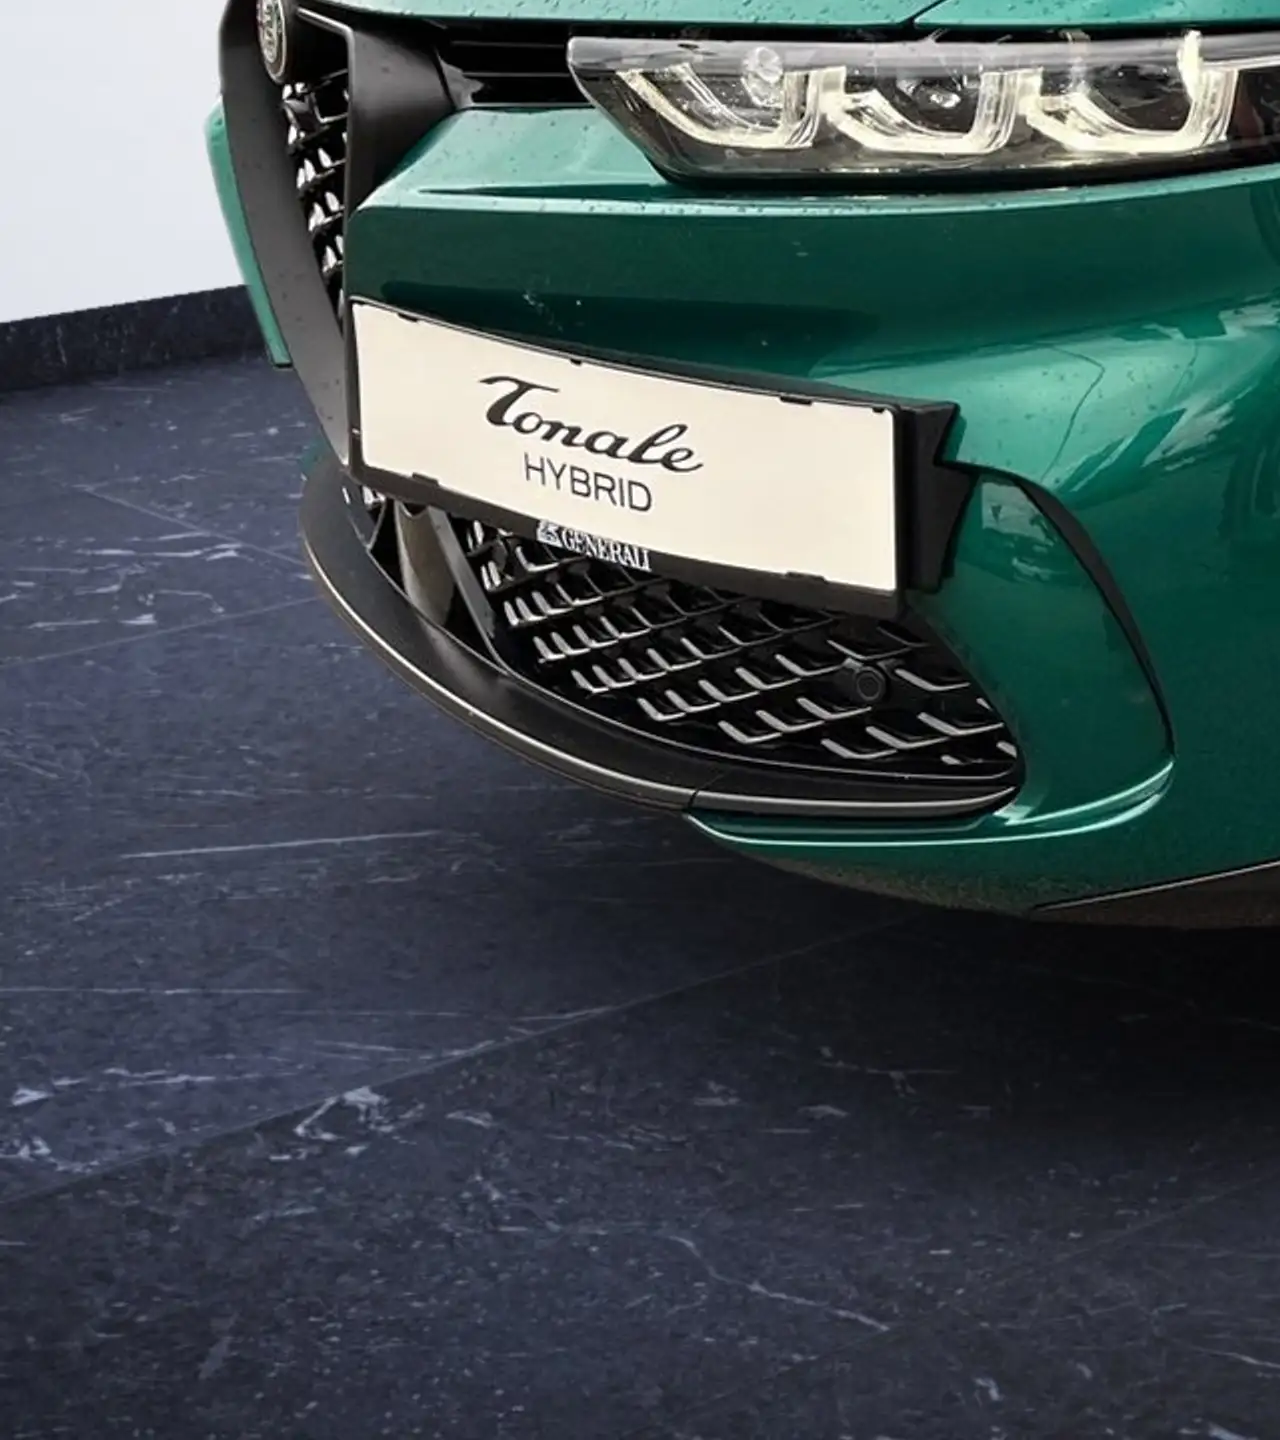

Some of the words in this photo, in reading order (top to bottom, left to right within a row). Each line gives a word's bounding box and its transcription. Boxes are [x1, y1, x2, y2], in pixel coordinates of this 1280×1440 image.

[479, 375, 704, 473] Tonale
[523, 452, 653, 513] HYBRID
[561, 528, 652, 573] GENERALI
